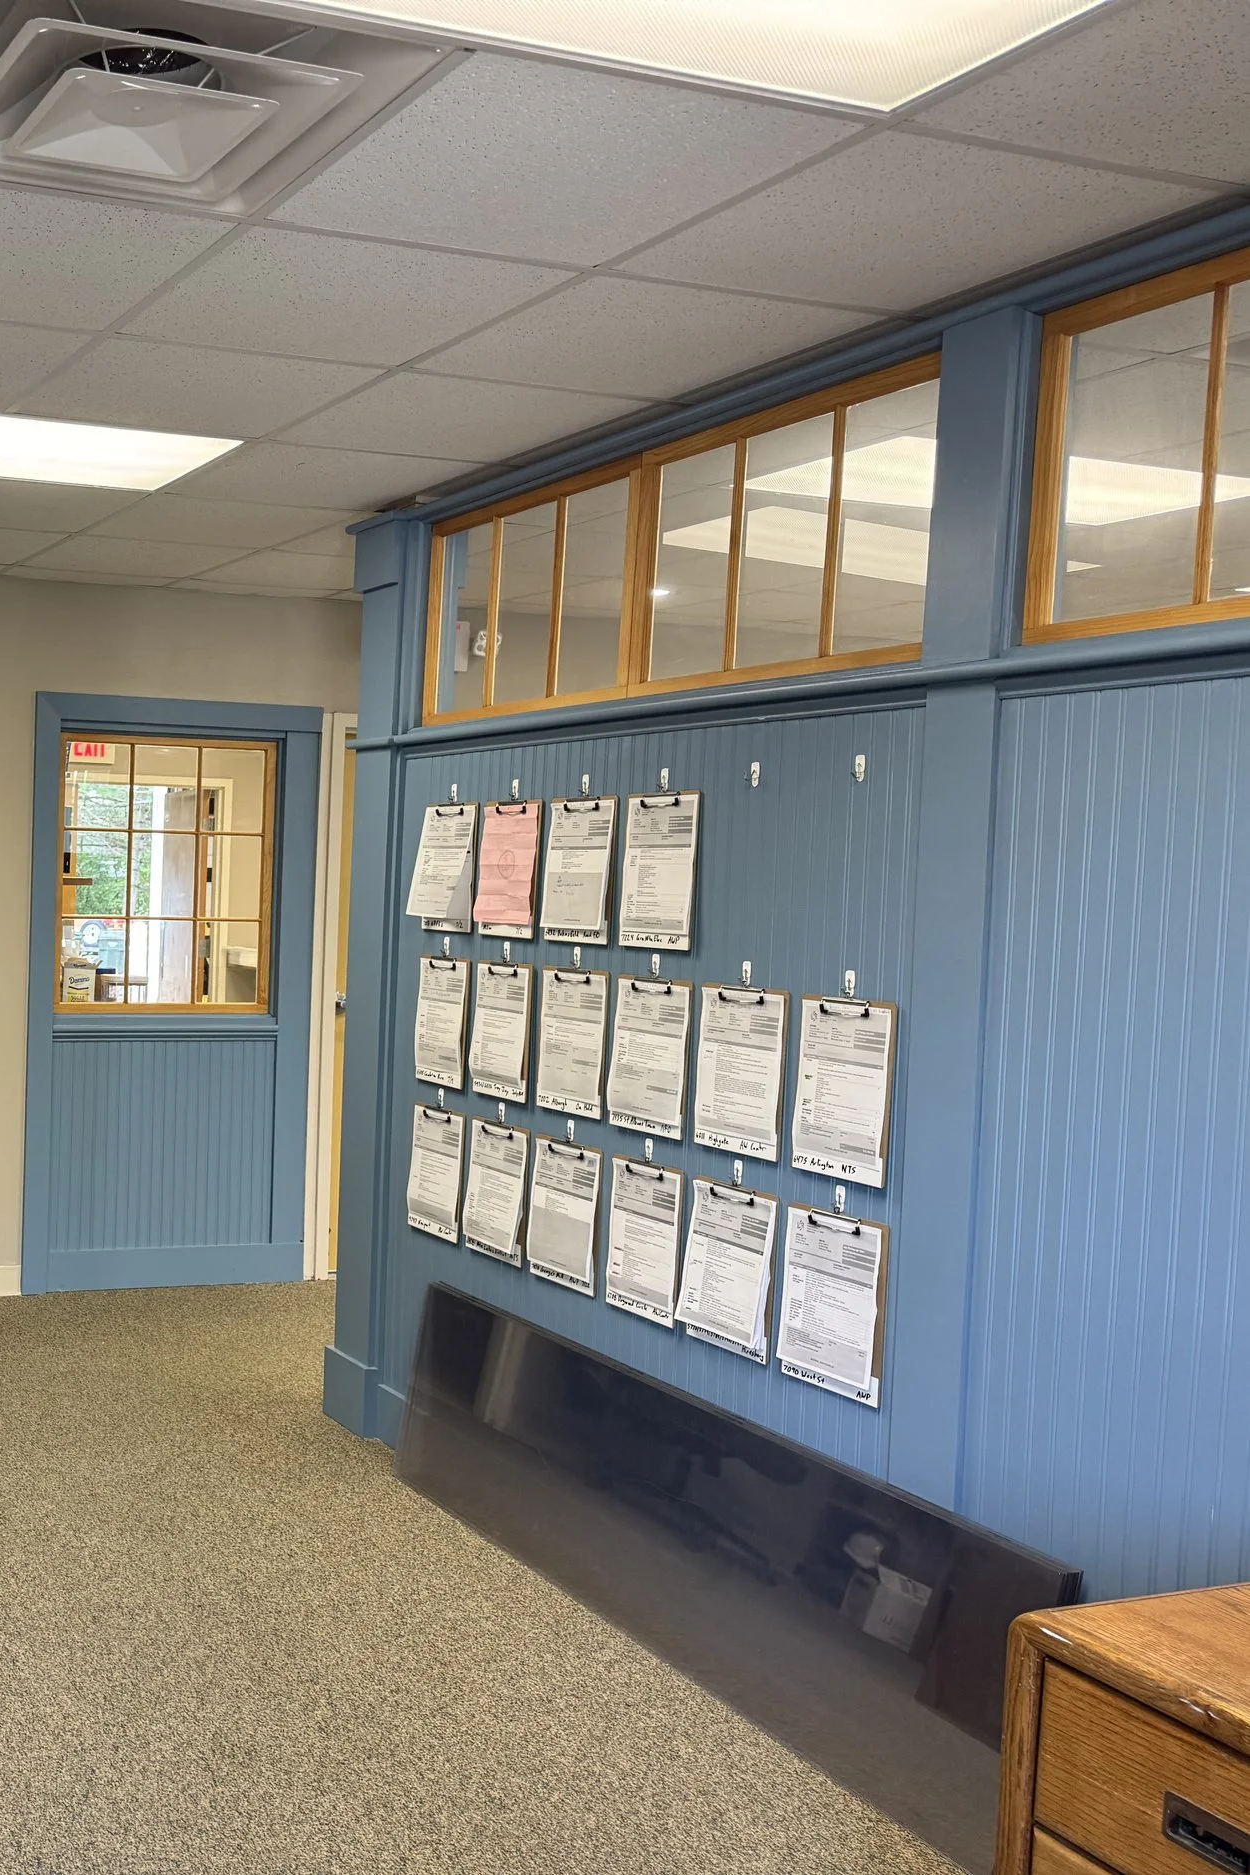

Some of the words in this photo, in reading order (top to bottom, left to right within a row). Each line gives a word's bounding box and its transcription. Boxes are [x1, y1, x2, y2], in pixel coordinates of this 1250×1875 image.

[708, 1133, 729, 1147] Highgate
[793, 1155, 808, 1165] 6475
[809, 1157, 834, 1170] Arlington
[841, 1163, 857, 1174] NTS
[783, 1364, 799, 1376] 7090
[800, 1370, 816, 1381] West
[816, 1375, 825, 1384] St
[855, 1390, 872, 1400] AWP
